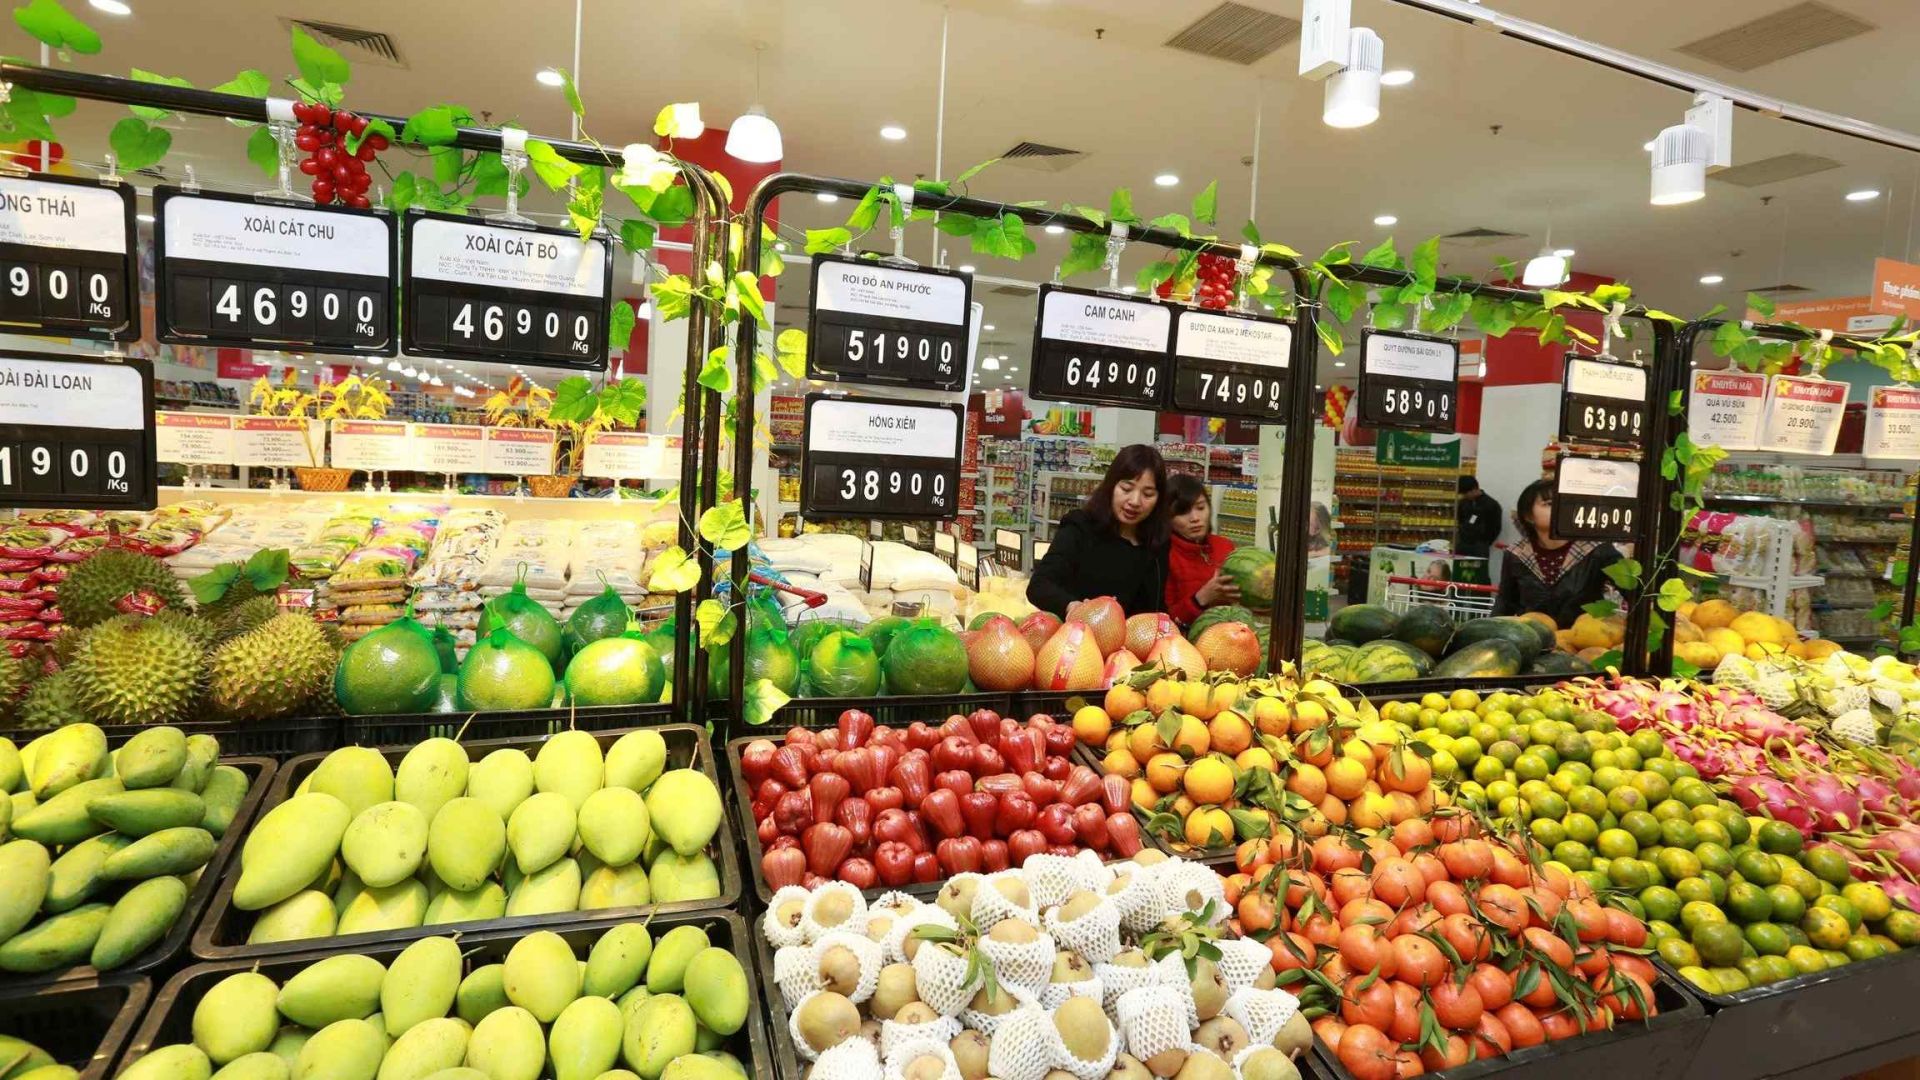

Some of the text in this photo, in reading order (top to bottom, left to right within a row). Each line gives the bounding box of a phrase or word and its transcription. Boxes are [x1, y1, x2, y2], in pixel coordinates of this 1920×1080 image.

[37, 195, 75, 218] THÁI
[244, 215, 335, 240] XOÀI CÁT CHU
[465, 232, 500, 254] XOÀI
[504, 236, 534, 257] CÁT
[879, 279, 894, 290] AN
[89, 302, 111, 318] /Kg
[1084, 304, 1136, 322] CAM CANH
[356, 323, 374, 337] /Kg
[572, 340, 589, 354] /Kg
[938, 362, 952, 375] /Kg
[24, 369, 48, 388] ĐÀI
[53, 374, 92, 391] LOAN
[1142, 386, 1155, 398] /Kg
[107, 479, 129, 493] /Kg
[931, 495, 945, 507] /Kg
